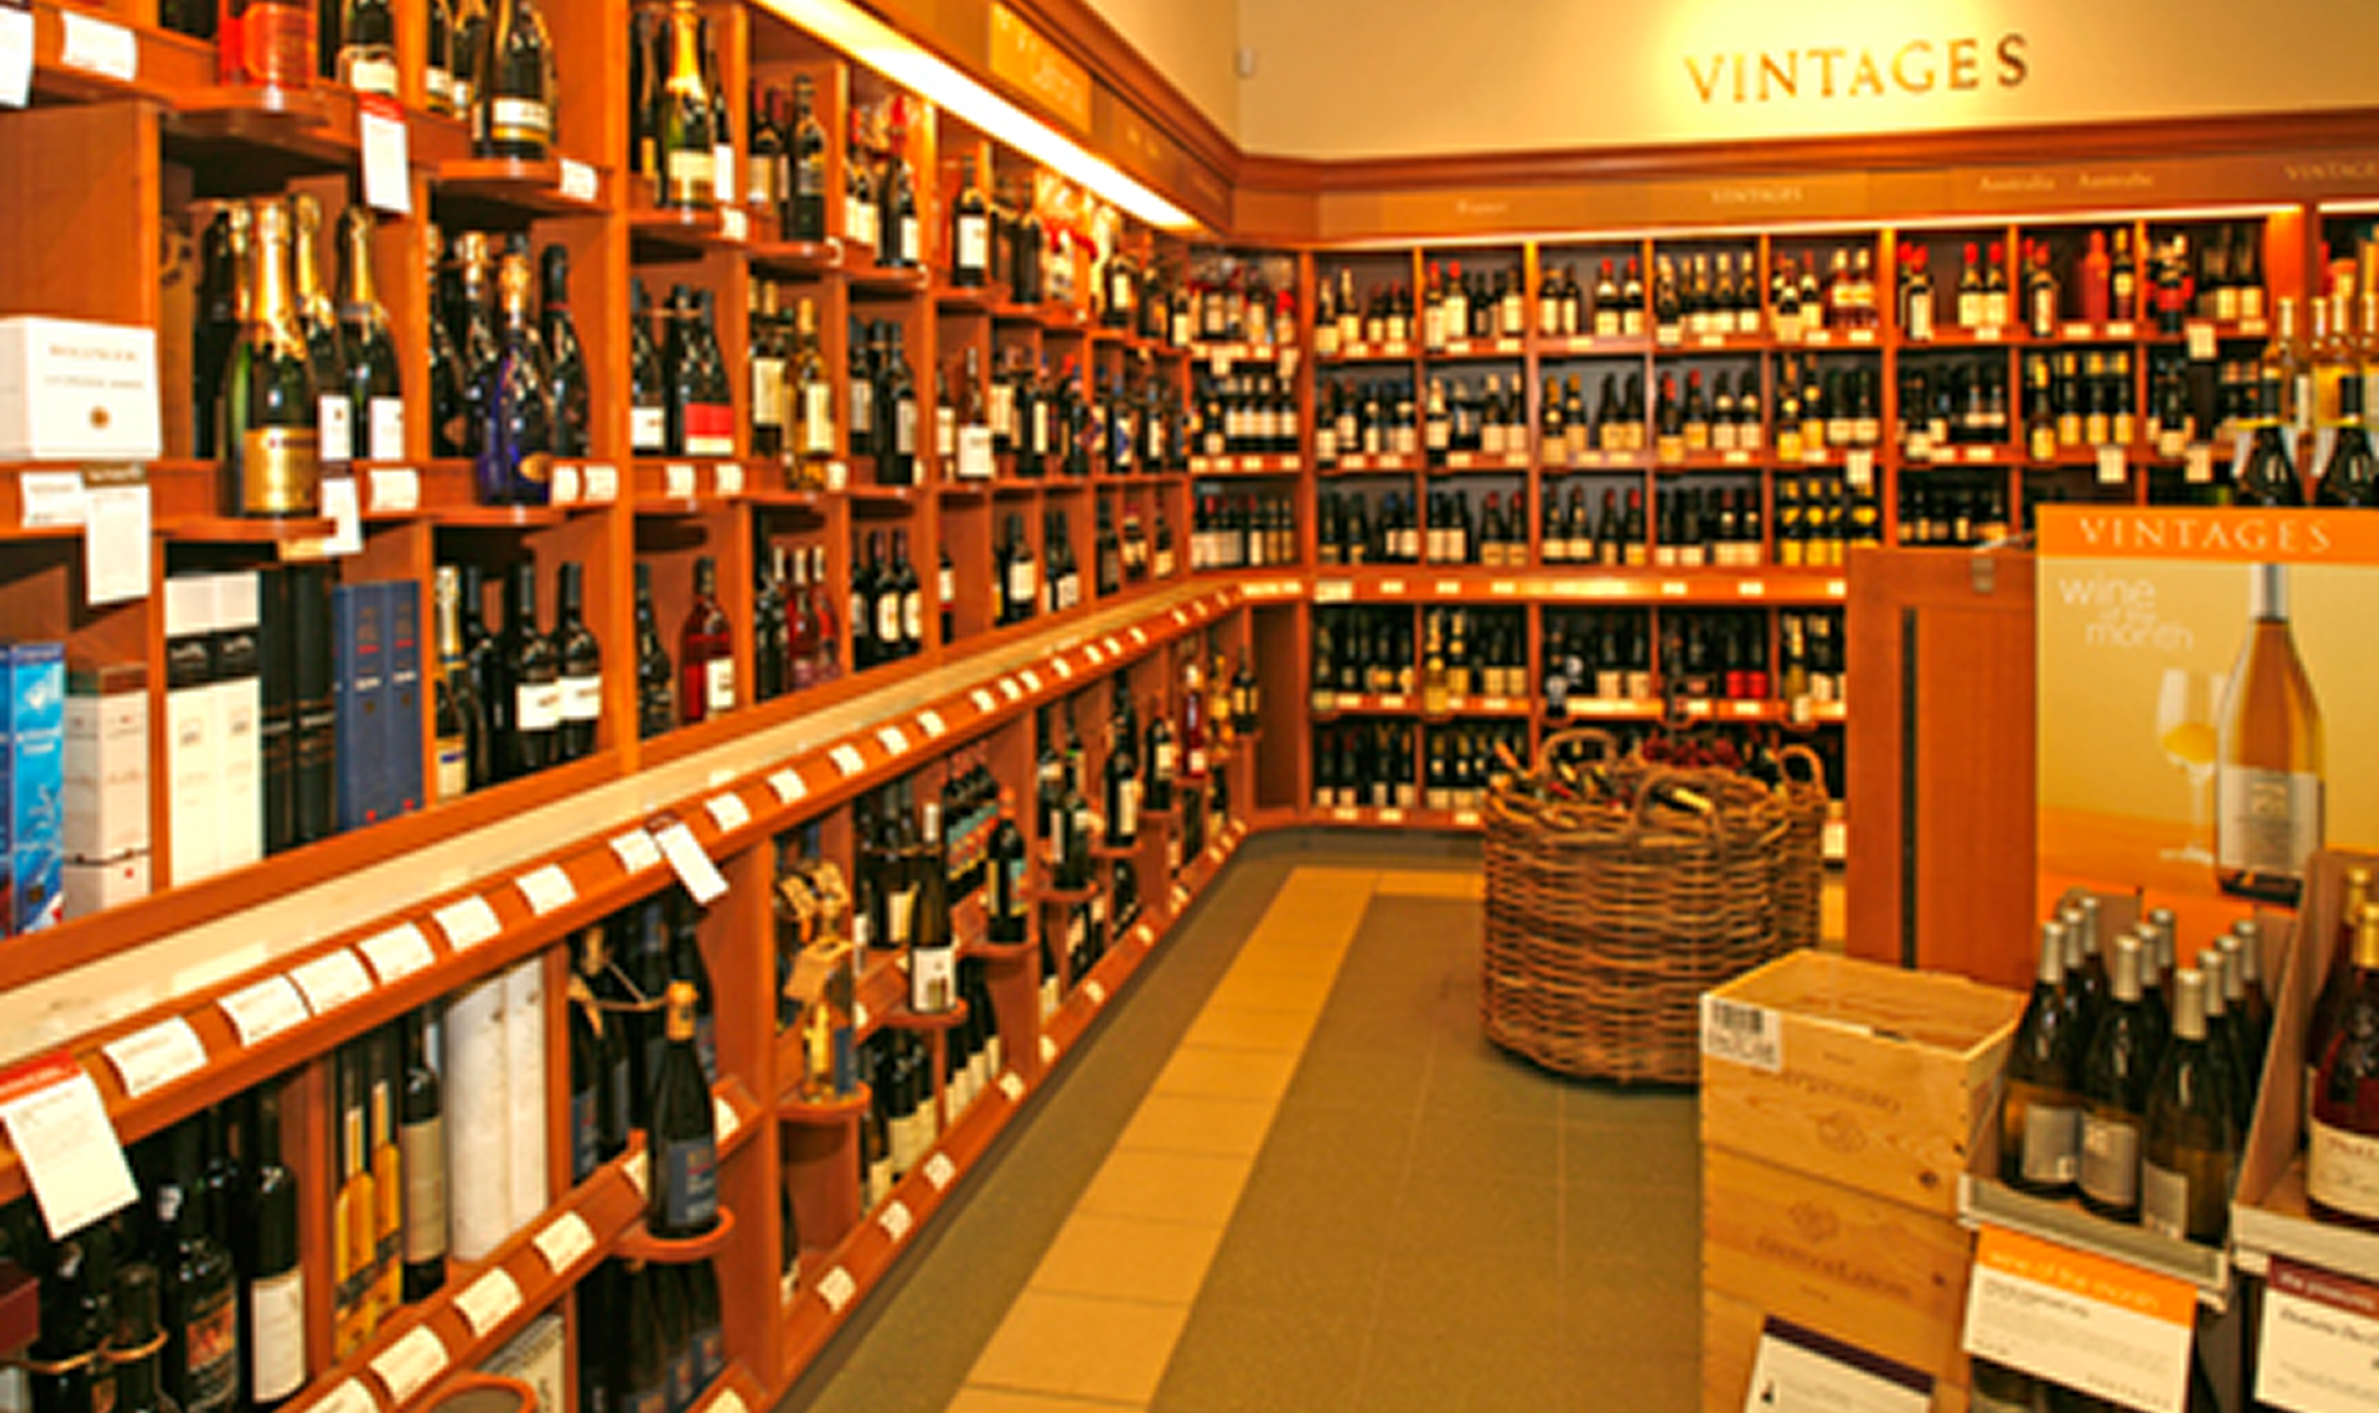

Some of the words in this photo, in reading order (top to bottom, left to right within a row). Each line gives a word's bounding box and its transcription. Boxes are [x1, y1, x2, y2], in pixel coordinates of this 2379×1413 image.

[1684, 32, 2028, 103] VINTAGES
[2078, 517, 2332, 553] VINTAGES
[2058, 570, 2156, 605] wine
[2085, 621, 2194, 651] month
